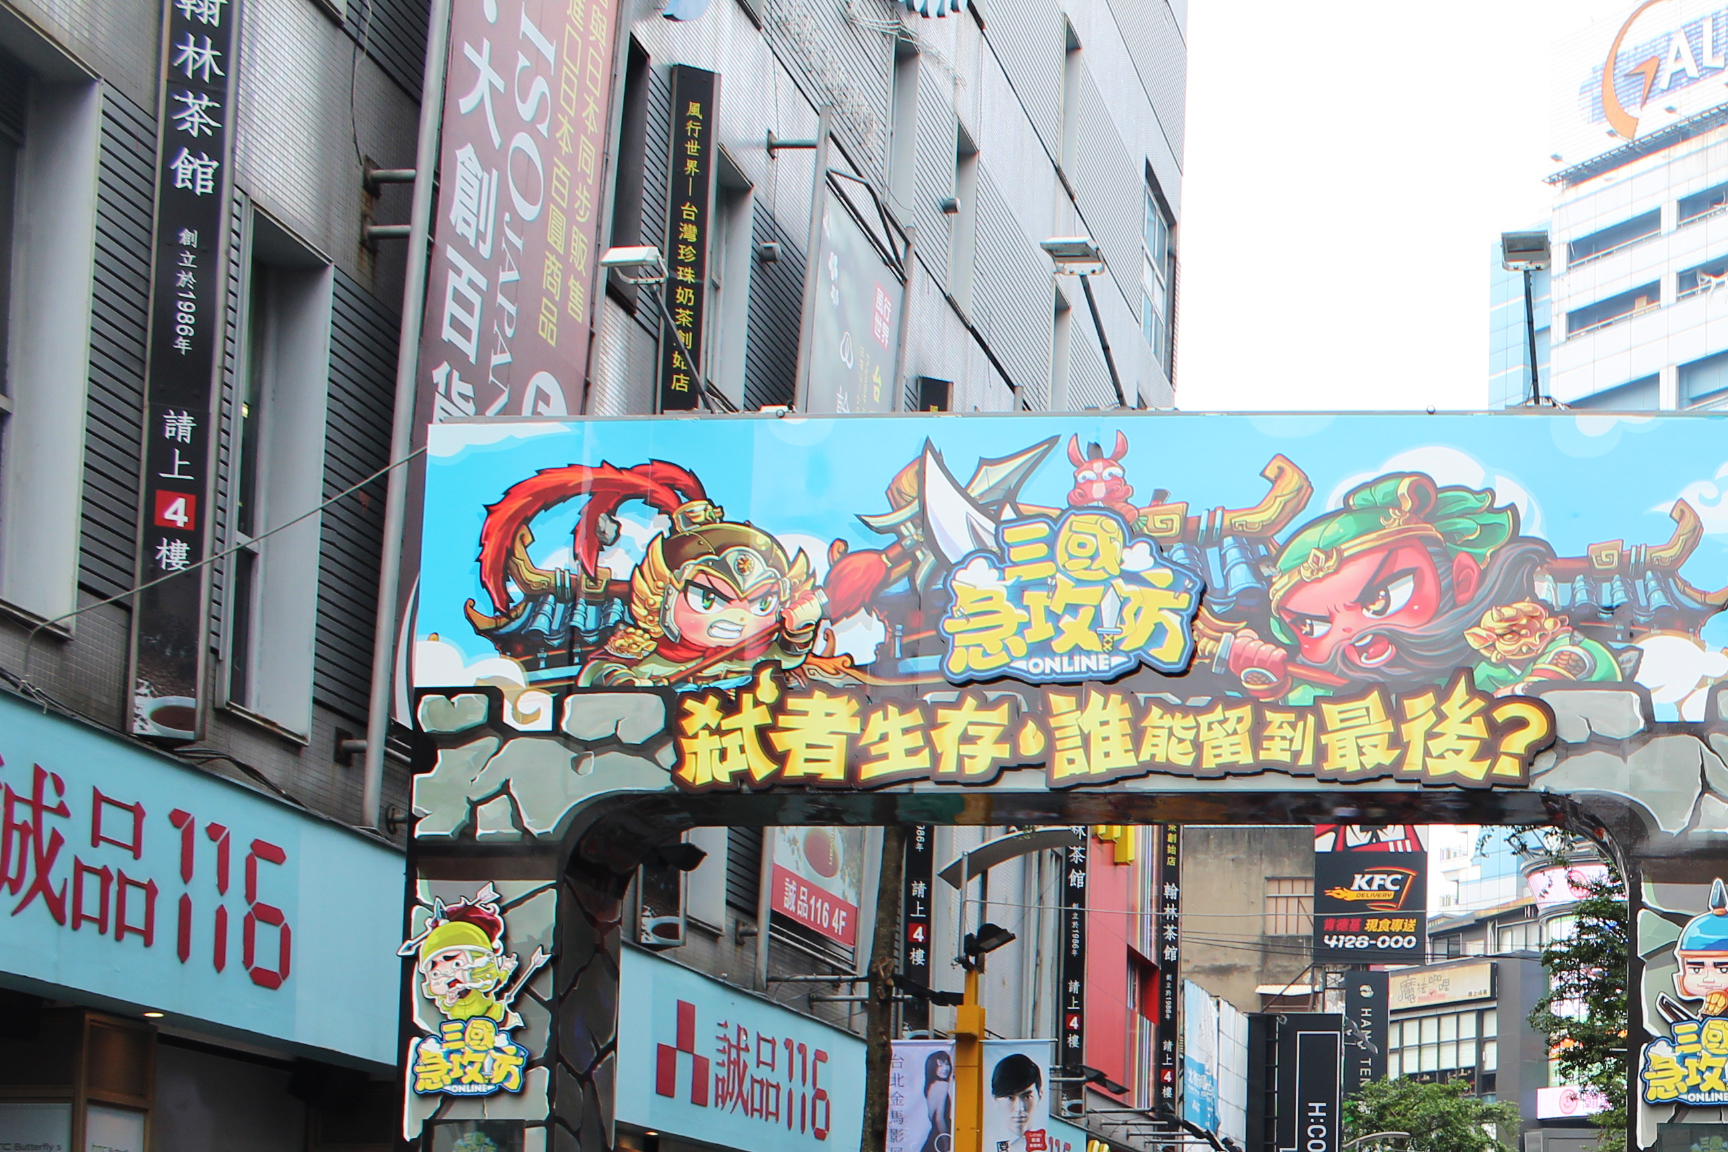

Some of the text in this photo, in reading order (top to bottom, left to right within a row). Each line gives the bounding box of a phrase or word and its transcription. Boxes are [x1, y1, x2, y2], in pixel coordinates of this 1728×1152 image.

[155, 409, 197, 572] 請上4樓
[1027, 654, 1112, 675] ONLINE
[1350, 874, 1403, 891] KFC
[1355, 891, 1393, 900] DELIVERY
[783, 877, 847, 936] 誠品116 4F
[909, 881, 927, 966] 請上4樓
[1323, 935, 1417, 950] 4128-000
[1067, 980, 1080, 1048] 請上4樓
[1359, 1008, 1372, 1049] HAN
[450, 1084, 488, 1093] ONLINE
[714, 1020, 831, 1141] 誠品116
[14, 1142, 54, 1152] Butterfly
